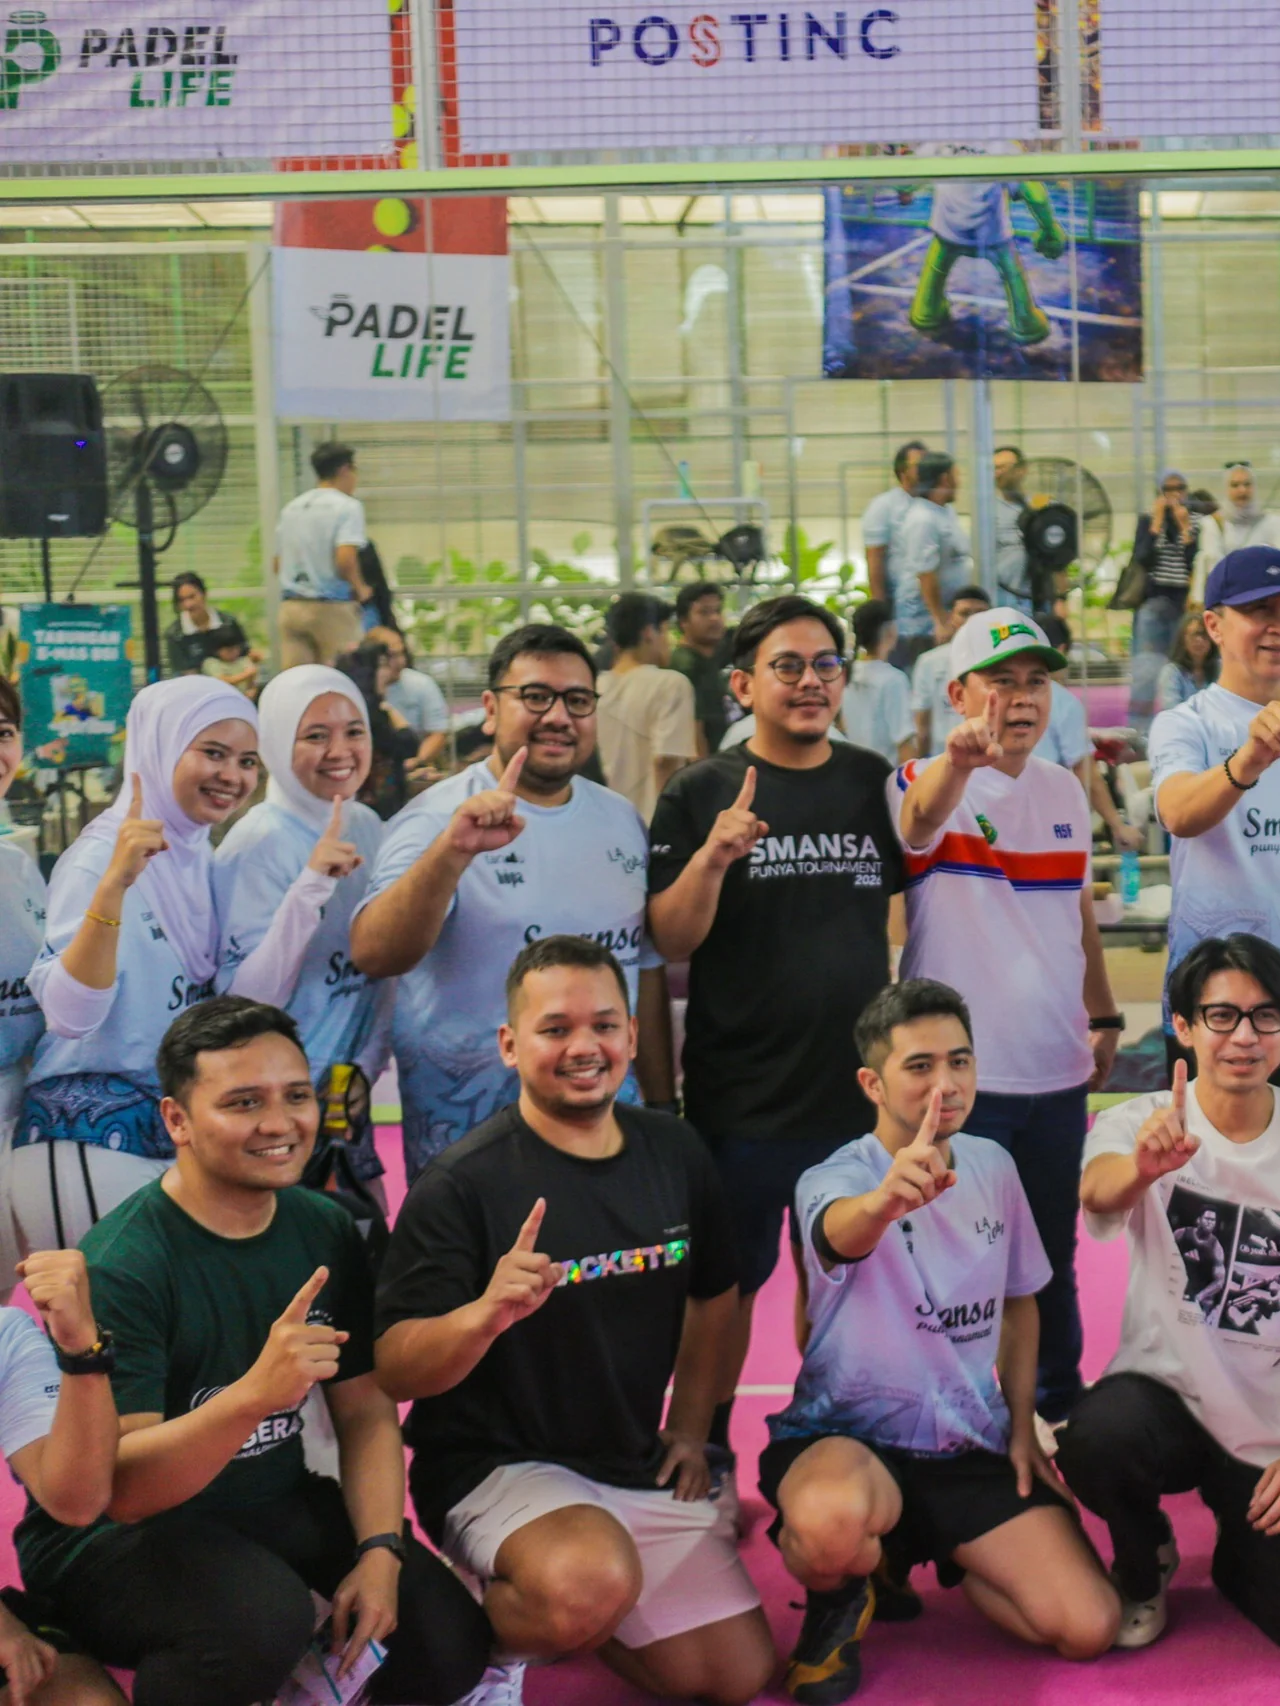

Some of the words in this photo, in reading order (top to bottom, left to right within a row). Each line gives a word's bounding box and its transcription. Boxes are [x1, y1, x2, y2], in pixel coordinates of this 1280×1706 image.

[79, 26, 238, 68] PADEL
[588, 9, 901, 67] POSTINC
[129, 70, 235, 108] LIFE
[324, 300, 475, 343] PADEL
[369, 342, 474, 380] LIFE
[750, 833, 880, 864] SMANSA
[750, 862, 795, 878] PUNYA
[797, 861, 883, 875] TOURNAMENT
